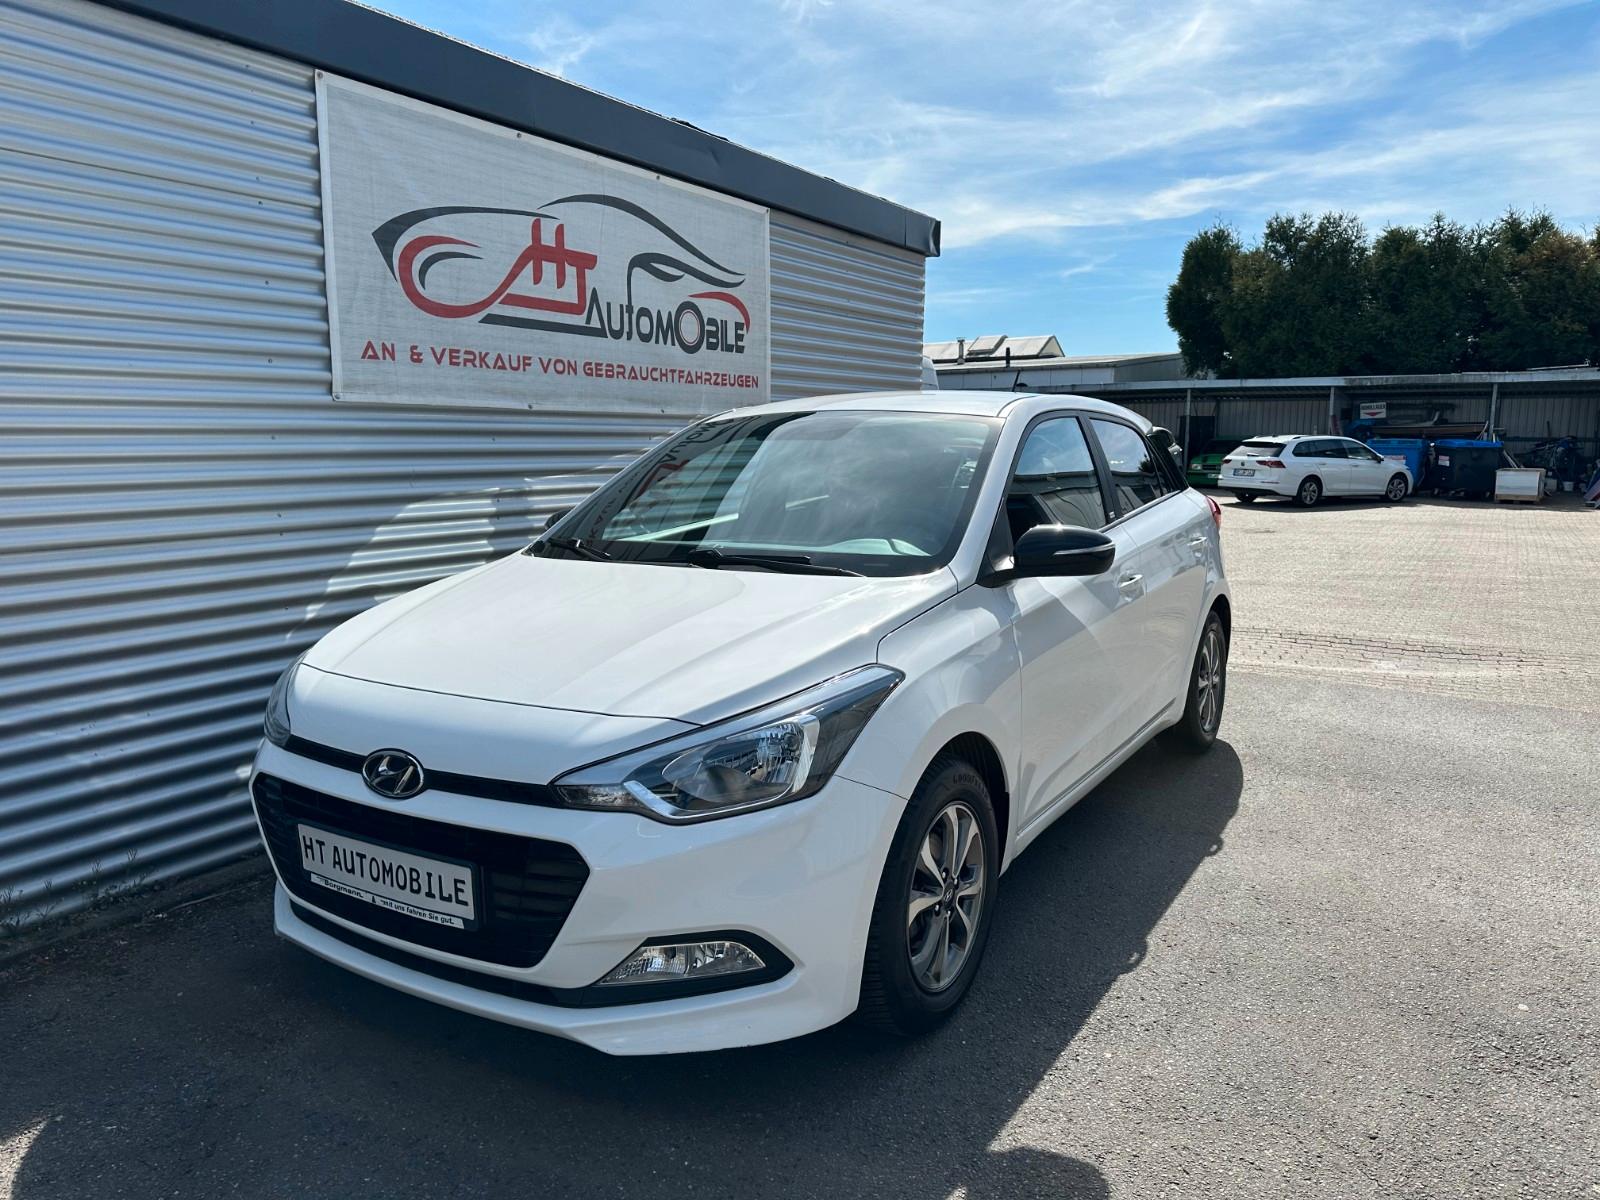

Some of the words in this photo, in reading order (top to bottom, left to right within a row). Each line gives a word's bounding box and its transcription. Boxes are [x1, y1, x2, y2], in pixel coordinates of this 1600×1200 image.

[361, 340, 396, 361] AN
[409, 345, 424, 364] &
[430, 346, 532, 372] VERKAUF
[538, 356, 578, 376] VON
[583, 361, 759, 388] GEBRAUCHTFAHRZEUGEN
[303, 835, 325, 864] HT
[333, 846, 469, 906] AUTOMOBILE
[394, 904, 405, 912] uns
[406, 906, 427, 918] fahren
[428, 912, 438, 922] Sie
